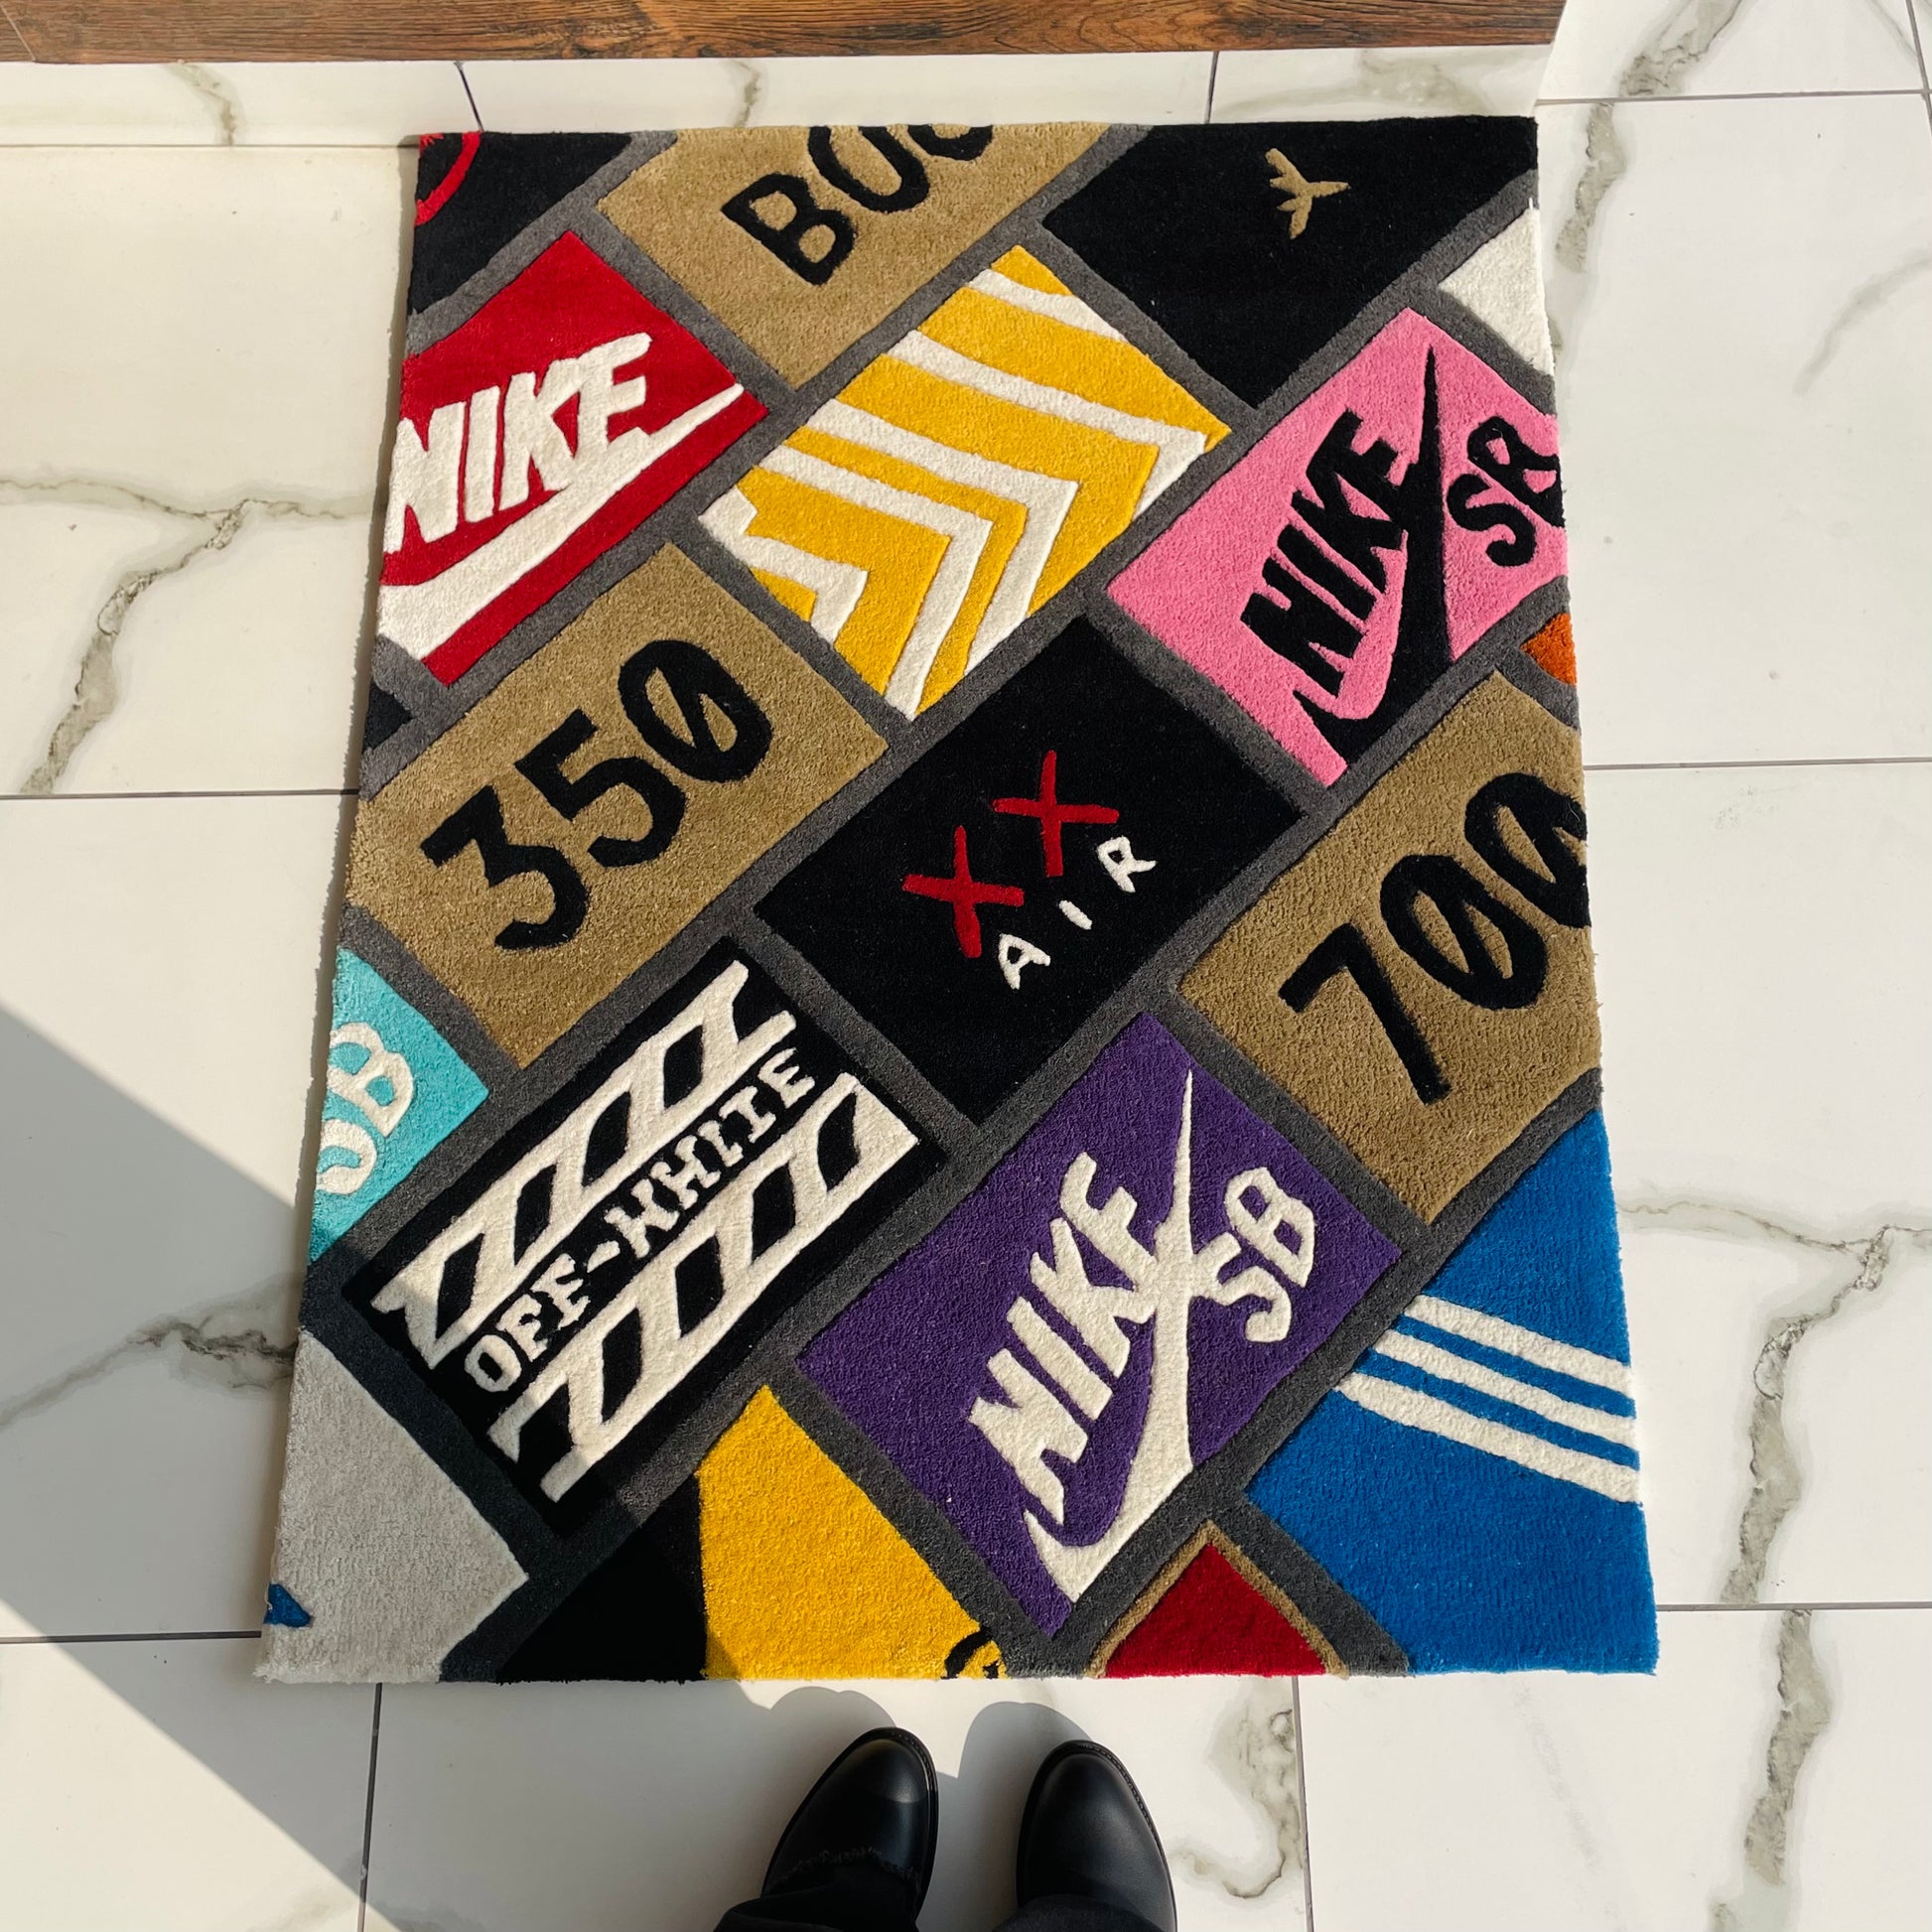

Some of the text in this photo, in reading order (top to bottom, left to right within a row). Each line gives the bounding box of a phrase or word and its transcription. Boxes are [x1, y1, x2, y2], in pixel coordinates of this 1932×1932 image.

[382, 333, 652, 554] NIKE
[1240, 408, 1408, 699] NIKE
[419, 639, 773, 951] 350
[998, 836, 1157, 990] AIR
[1278, 772, 1591, 1106] 700
[967, 1152, 1315, 1525] NIKE SB
